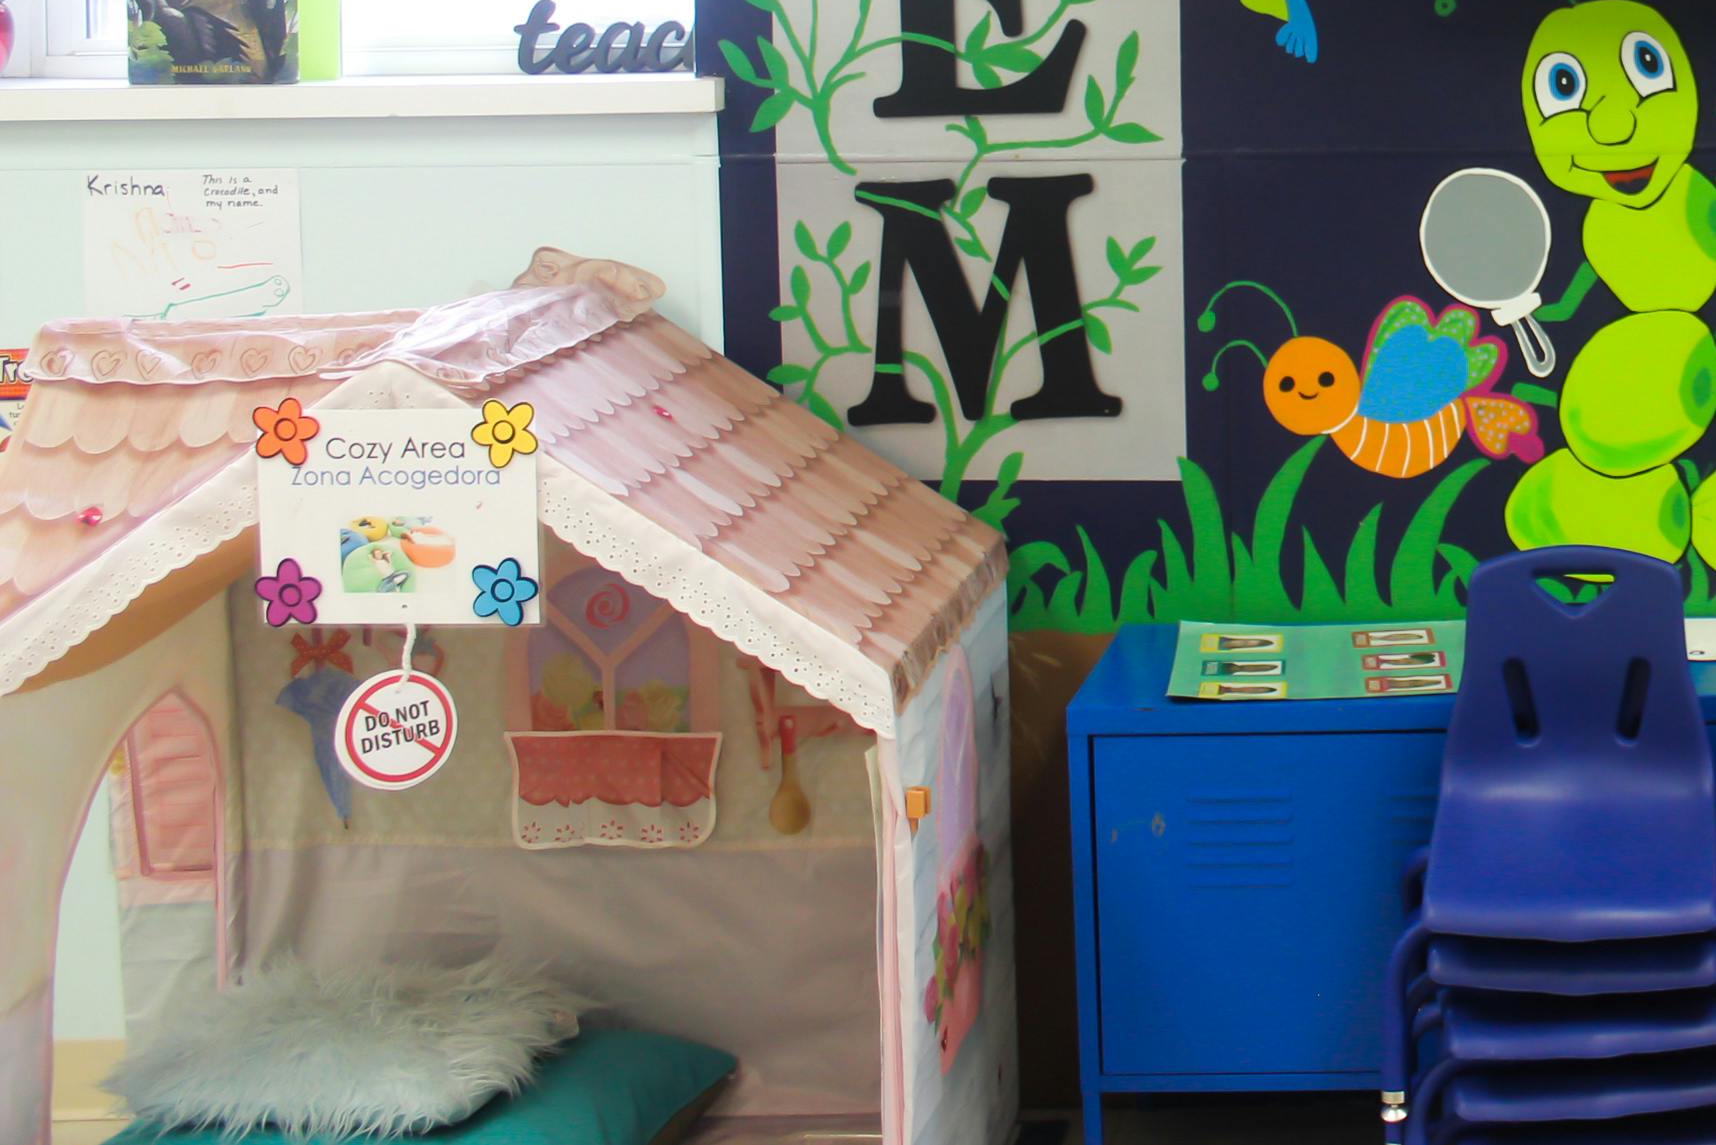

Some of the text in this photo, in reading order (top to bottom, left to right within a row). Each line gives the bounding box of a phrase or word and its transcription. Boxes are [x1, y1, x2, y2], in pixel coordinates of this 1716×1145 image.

[87, 175, 166, 197] Krishna
[258, 184, 278, 194] and
[206, 200, 222, 210] my
[325, 437, 465, 464] Cozy Area
[291, 465, 501, 489] Zona Acogedora
[365, 700, 430, 732] DO NOT
[361, 719, 441, 754] DISTURB
